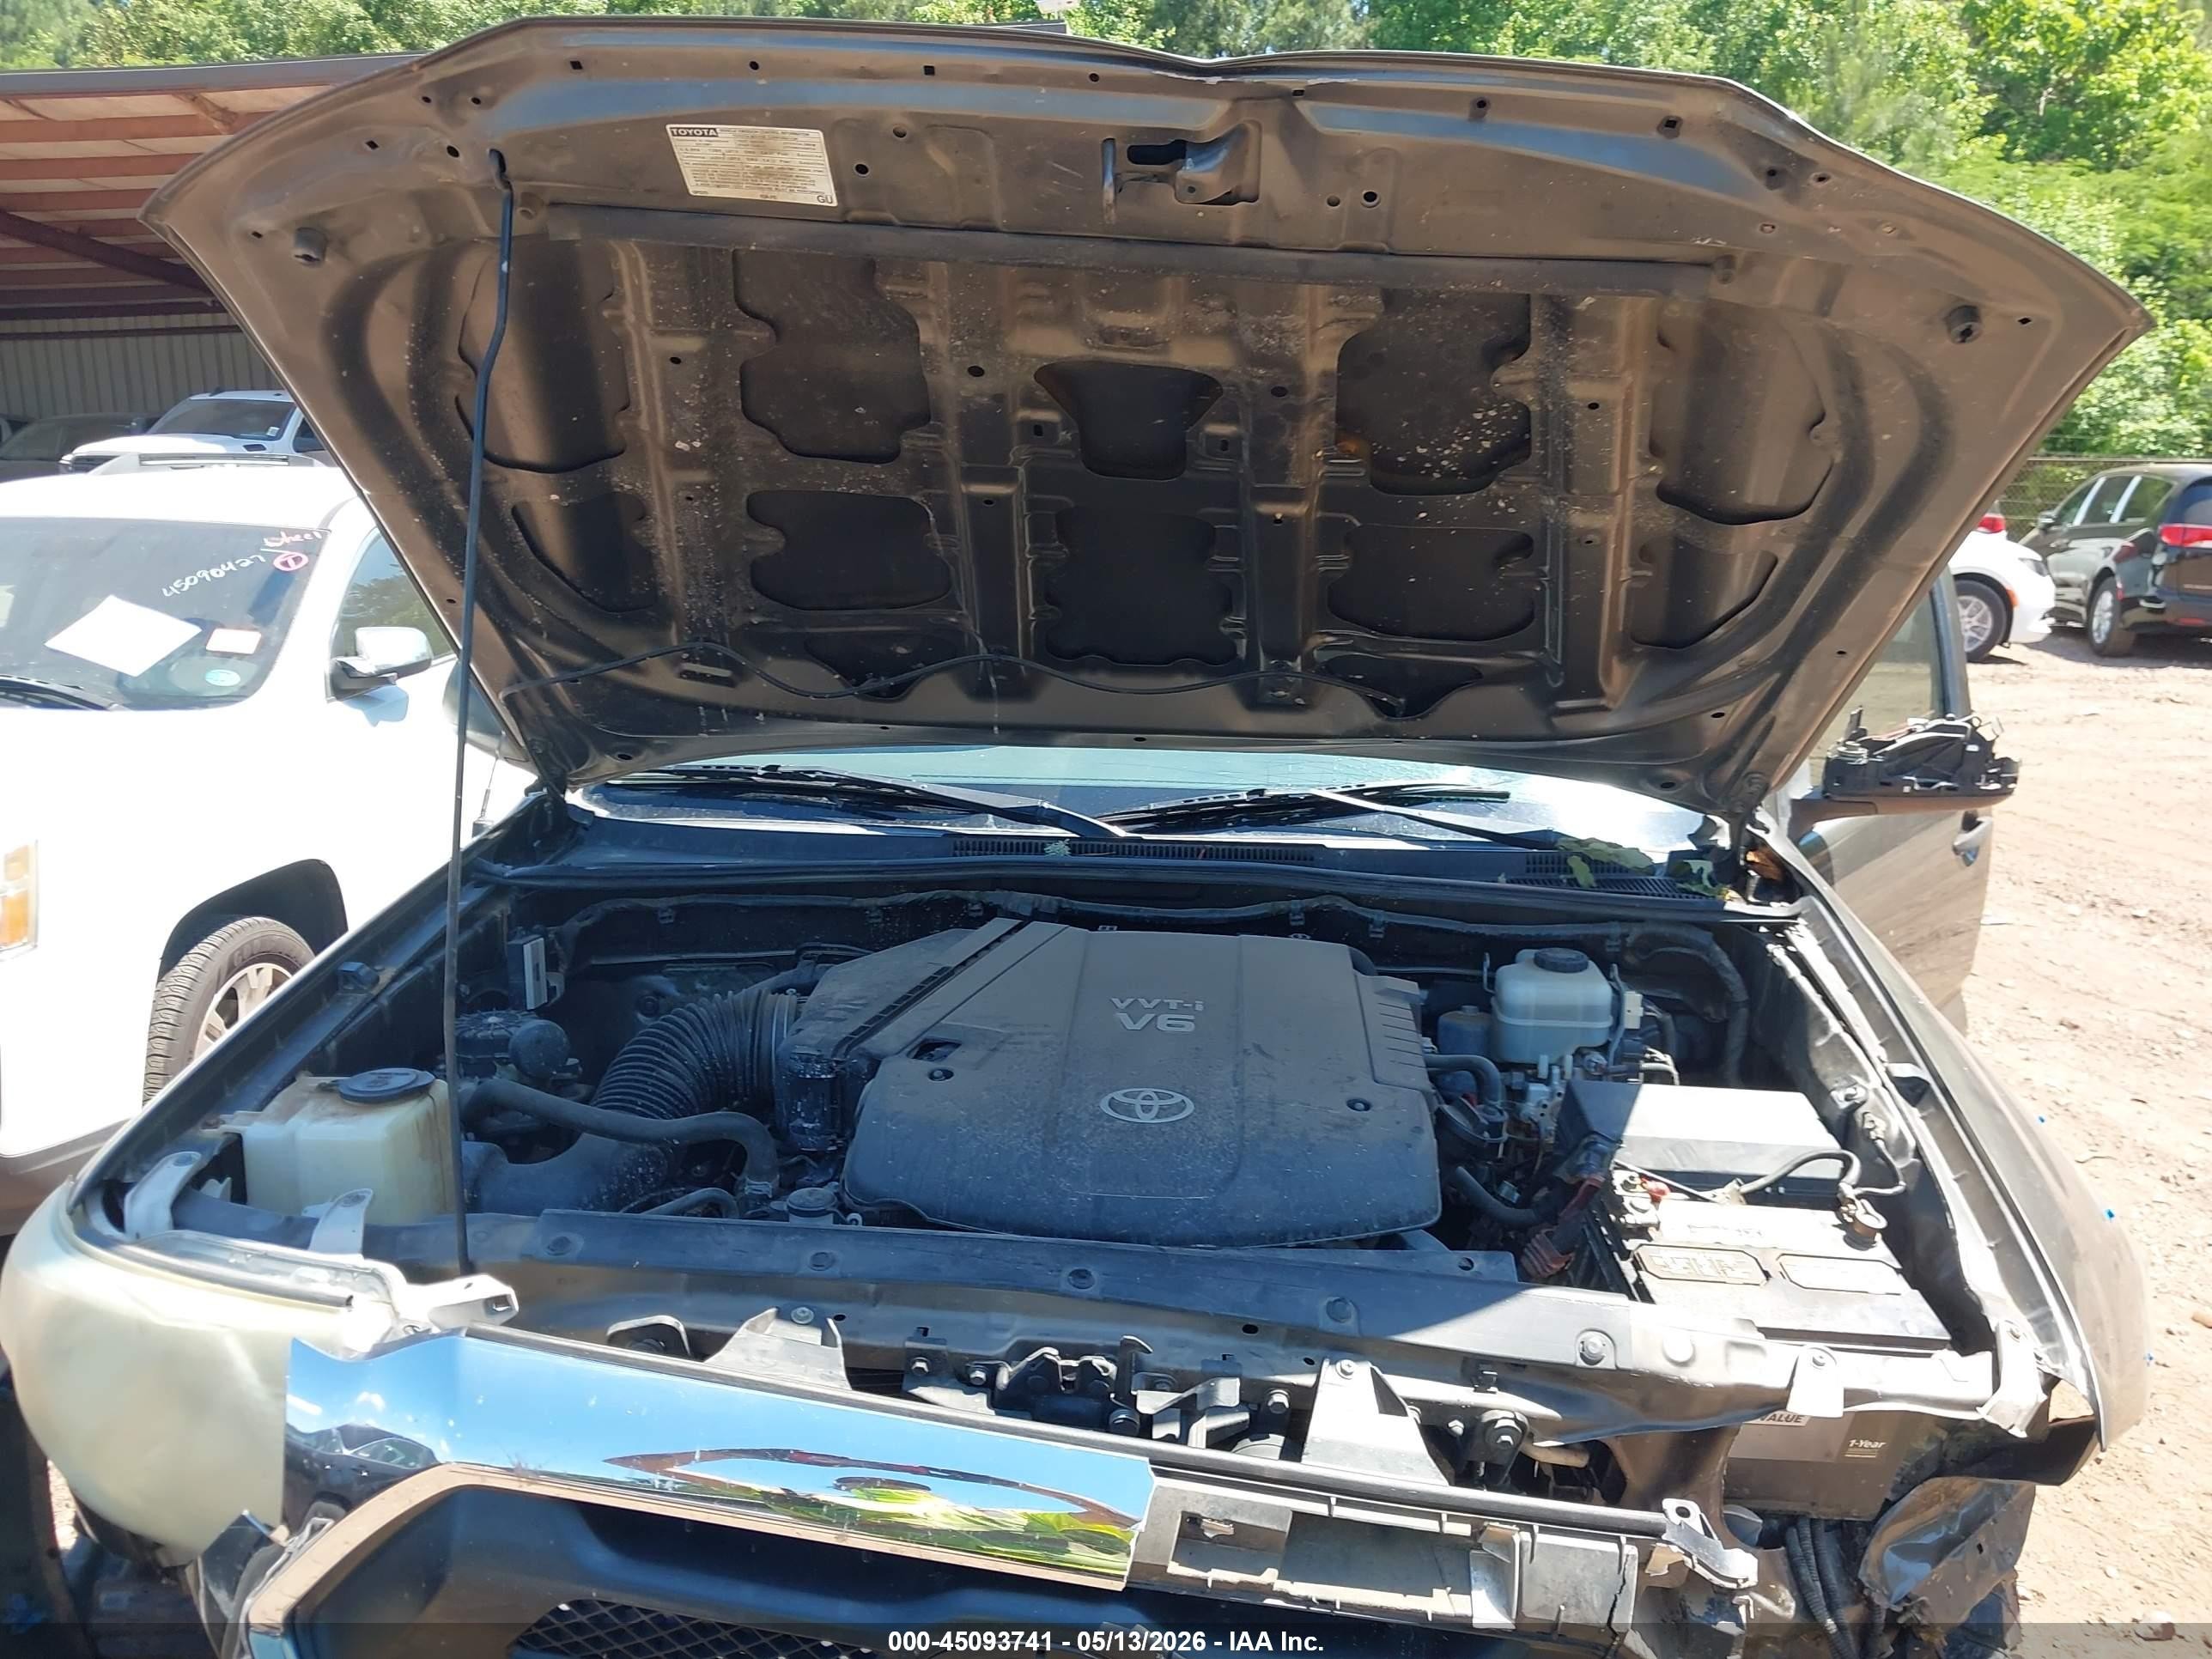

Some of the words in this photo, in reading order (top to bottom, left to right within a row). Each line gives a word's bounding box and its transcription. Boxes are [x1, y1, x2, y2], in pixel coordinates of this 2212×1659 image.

[672, 128, 718, 137] TOYOTA
[817, 195, 833, 204] GU
[161, 554, 266, 597] 45090427
[1110, 998, 1204, 1011] VVT-i
[1115, 1013, 1195, 1032] V6
[1849, 1438, 1887, 1449] 1-Year
